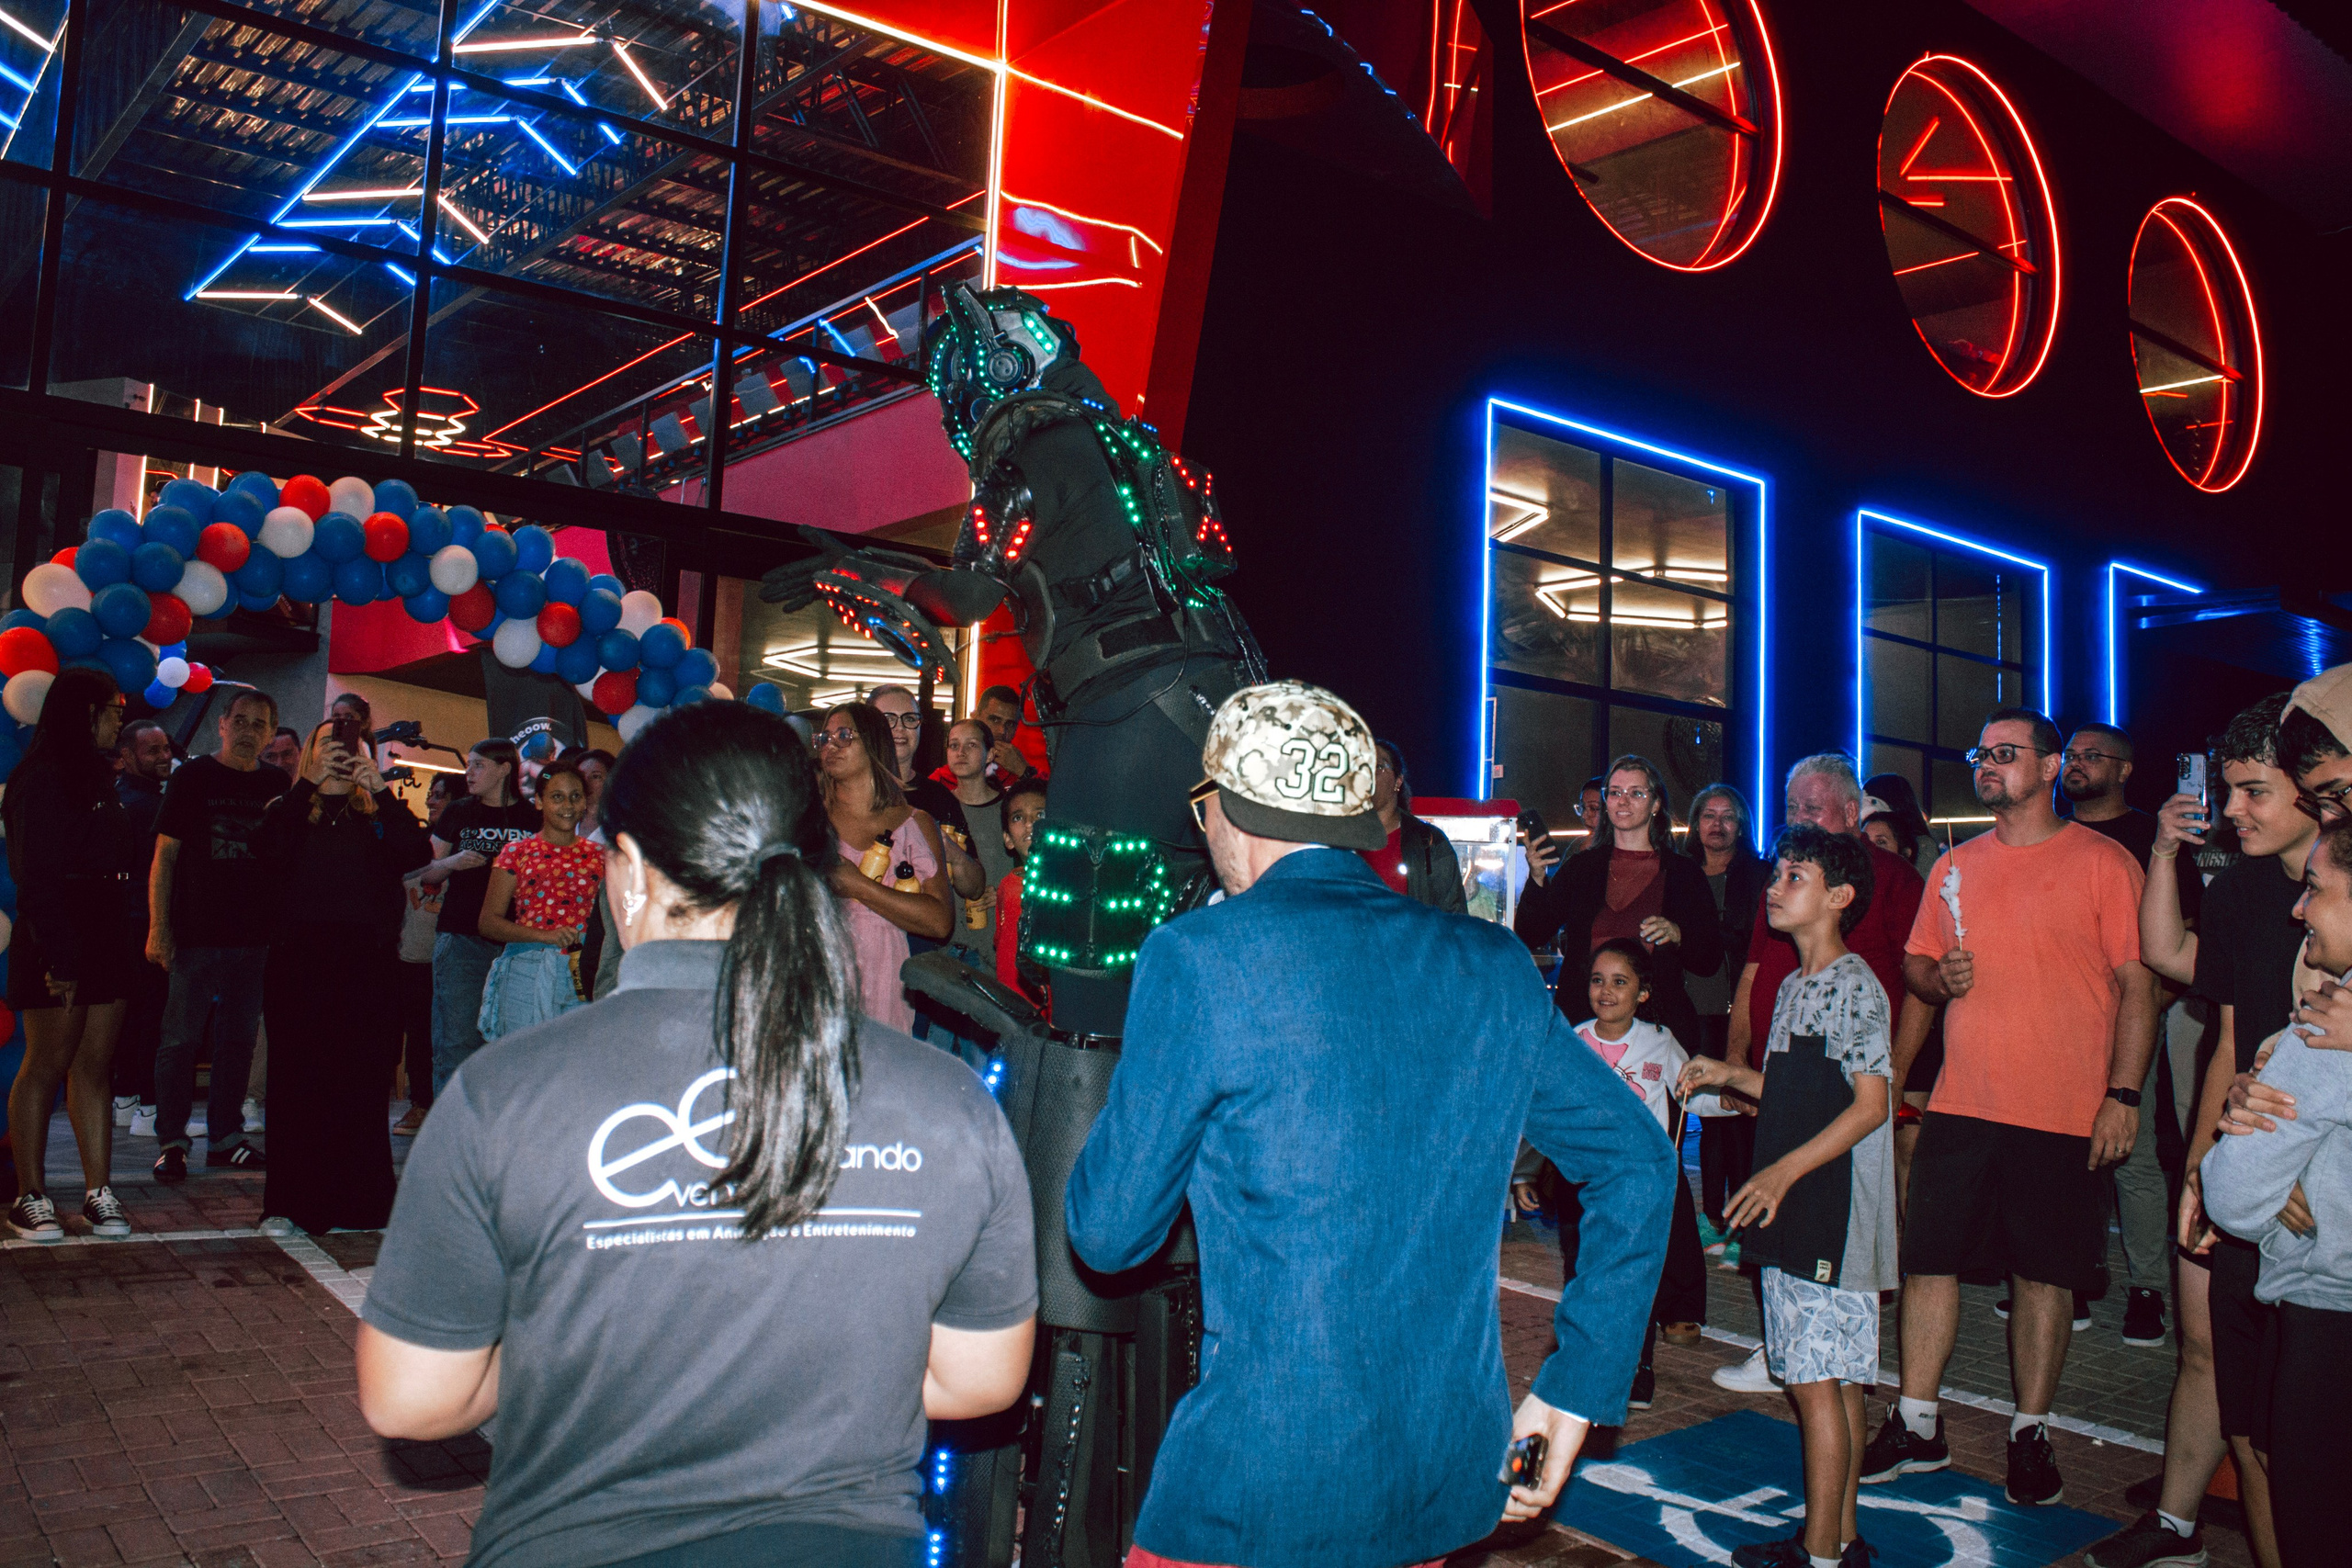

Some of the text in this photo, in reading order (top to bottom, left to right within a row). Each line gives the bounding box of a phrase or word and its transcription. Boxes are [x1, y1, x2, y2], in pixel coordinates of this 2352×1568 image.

[1275, 738, 1350, 803] 32
[585, 1227, 684, 1249] Especialistas
[686, 1226, 710, 1240] em
[803, 1221, 917, 1238] Entretenimento
